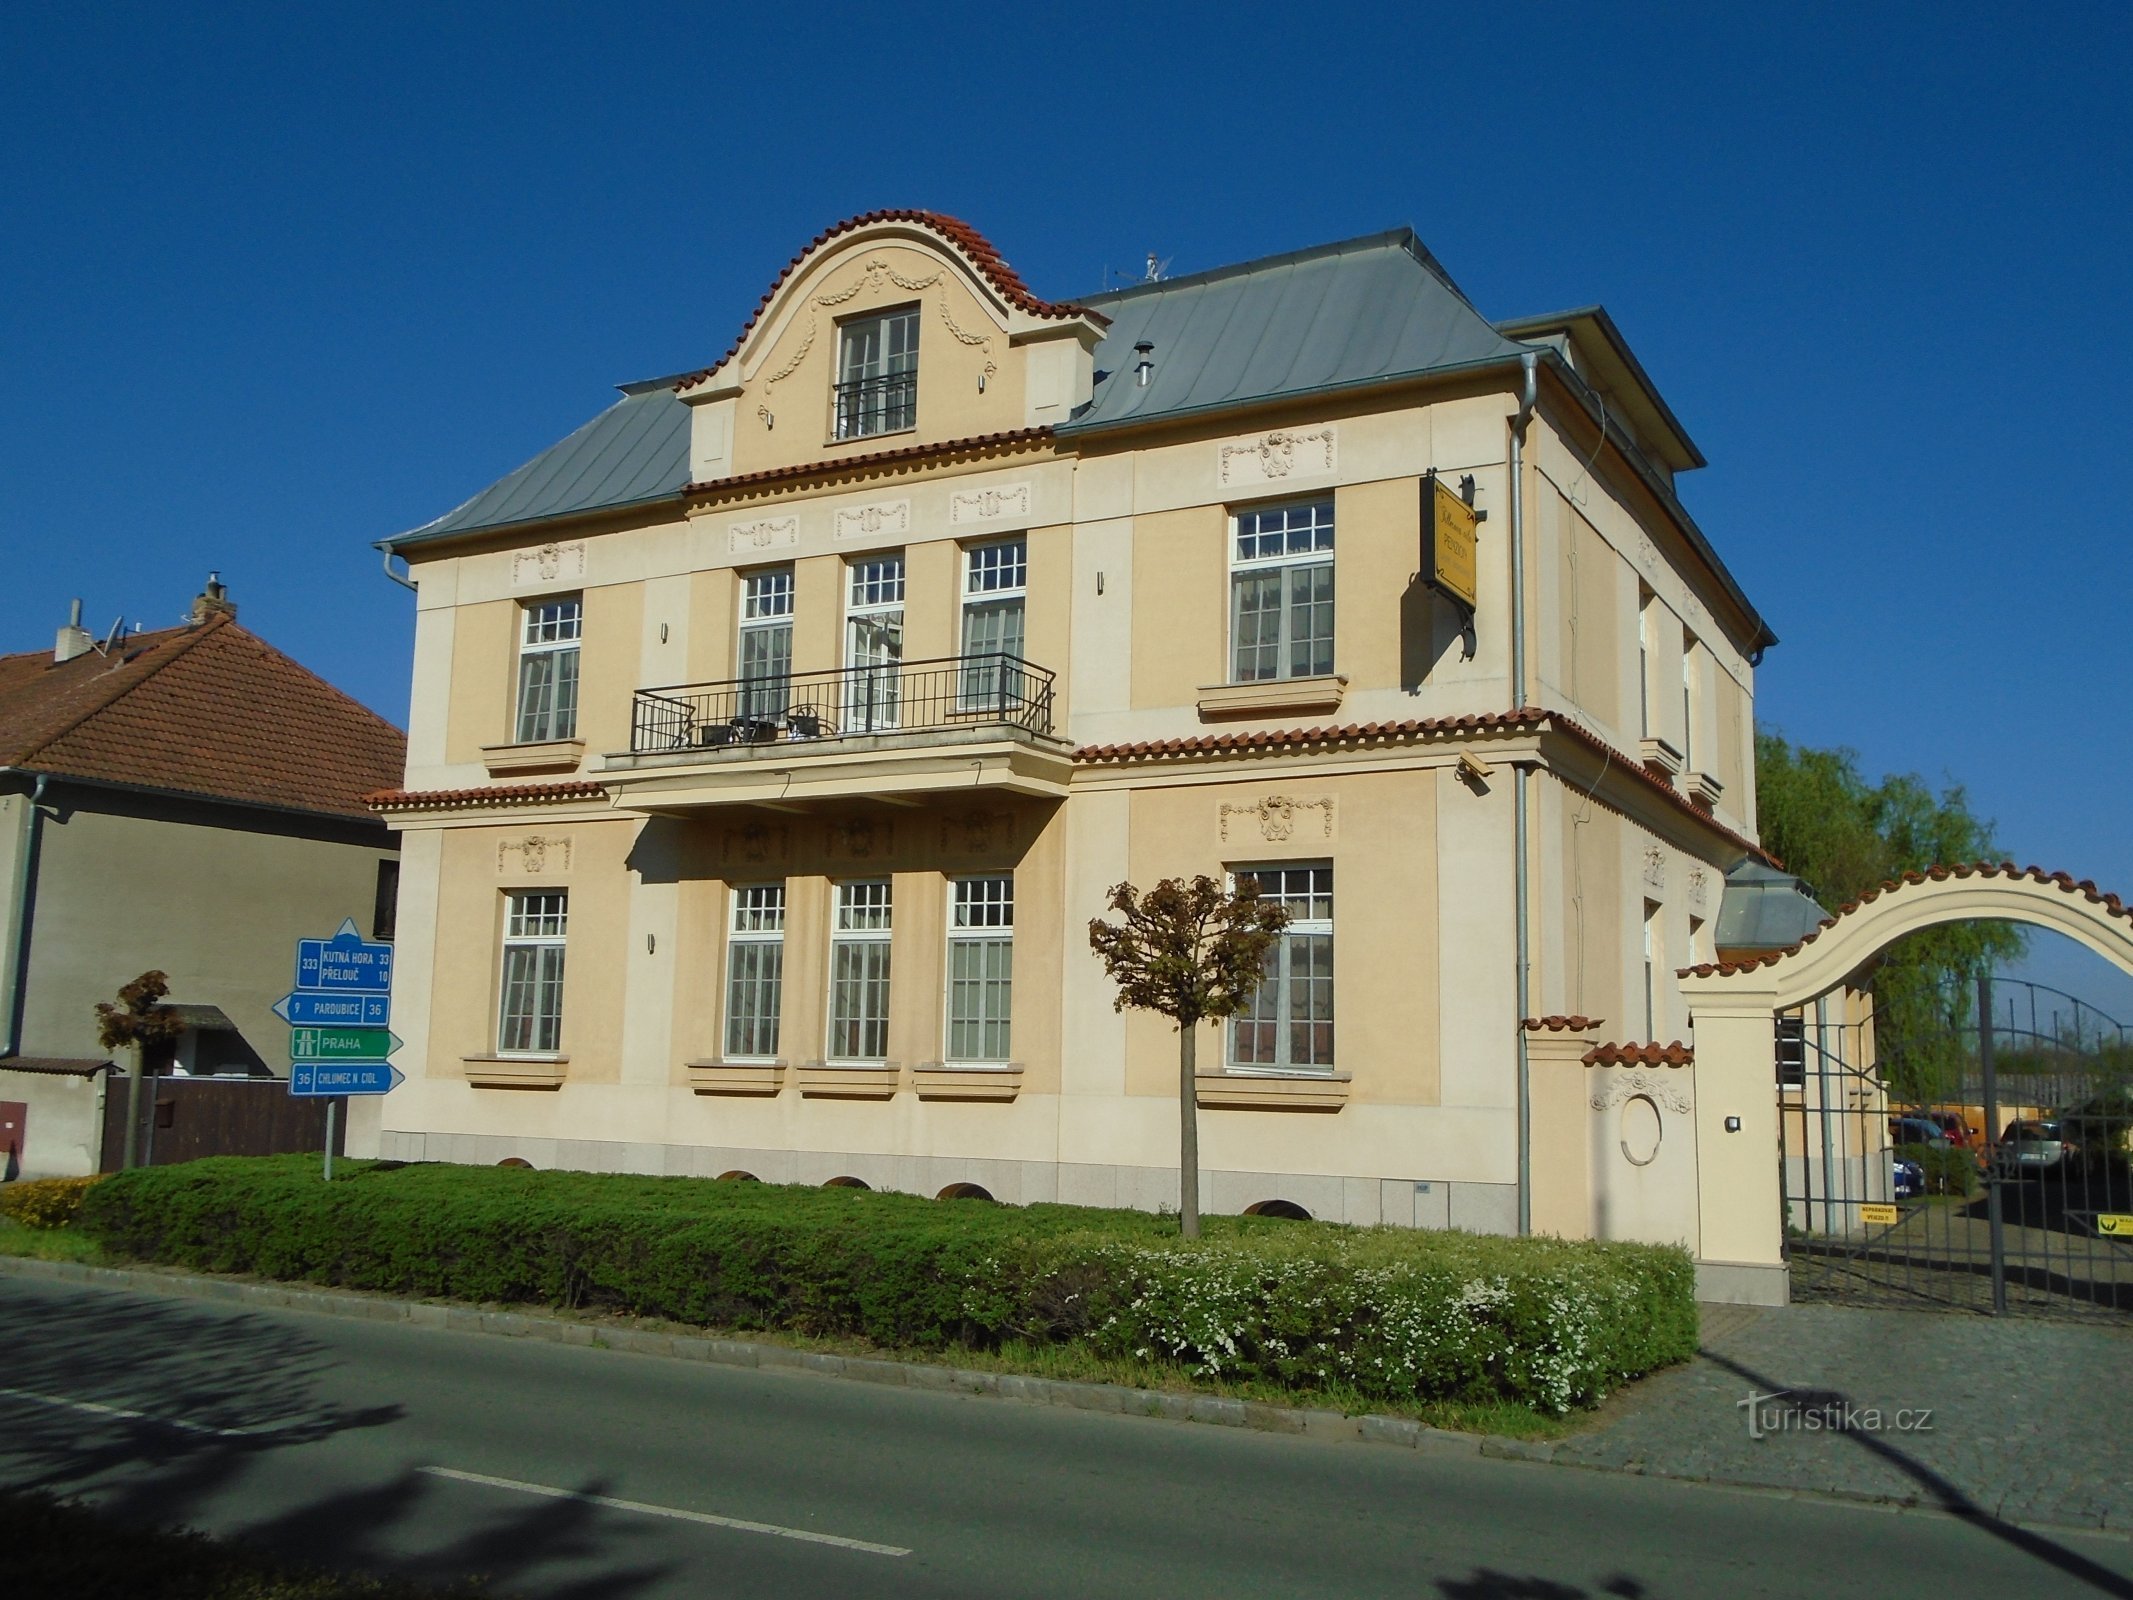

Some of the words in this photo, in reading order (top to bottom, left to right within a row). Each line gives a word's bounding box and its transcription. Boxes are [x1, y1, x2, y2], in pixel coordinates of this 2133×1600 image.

[323, 949, 350, 963] KUTNÁ
[352, 952, 373, 965] HORA
[379, 954, 389, 965] 33
[302, 958, 318, 970] 333
[322, 966, 359, 981] PŘELOUČ
[379, 971, 388, 982] 10
[294, 1002, 301, 1014] 9
[314, 1003, 360, 1015] PARDUBICE
[369, 1004, 382, 1015] 36
[322, 1037, 361, 1049] PRAHA
[297, 1073, 311, 1085] 36
[318, 1072, 351, 1084] CHLUMEC
